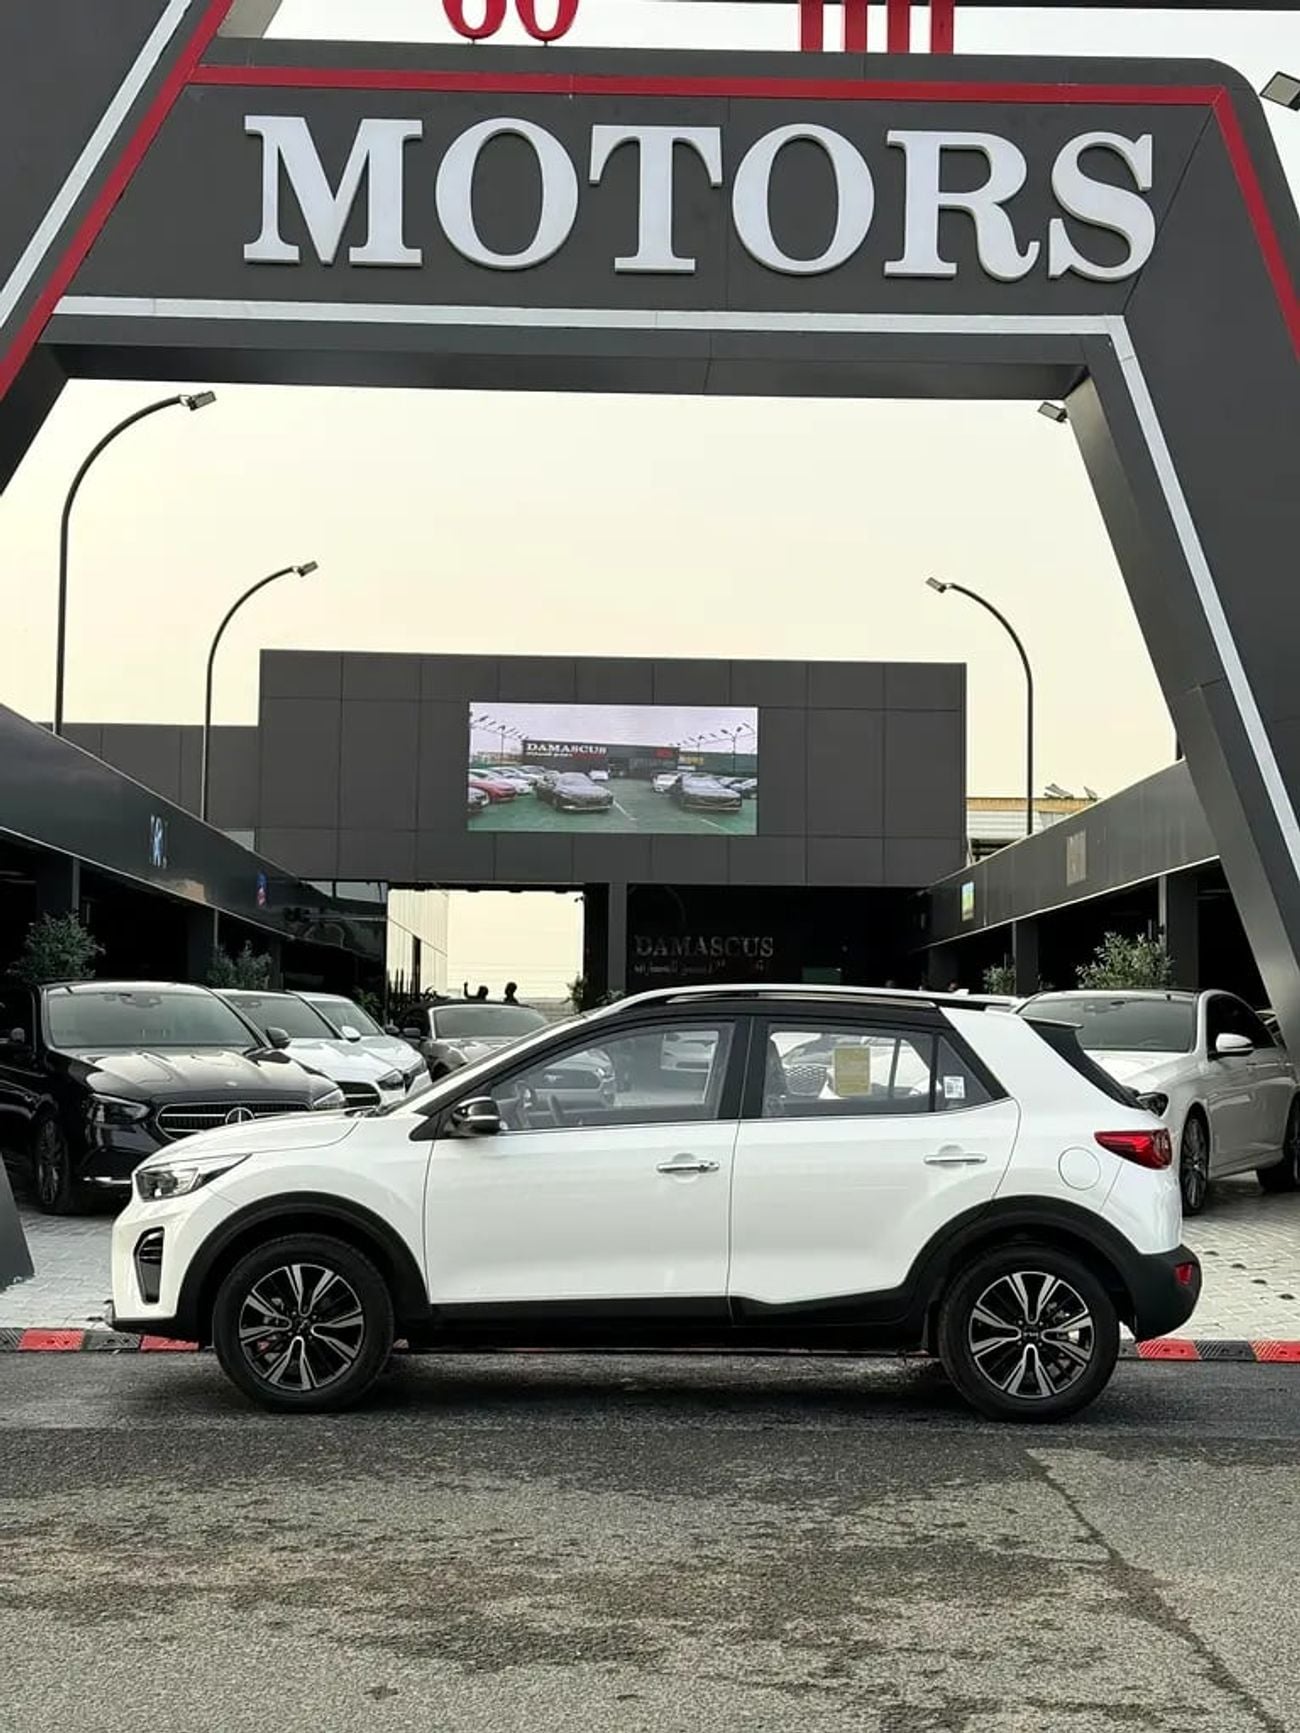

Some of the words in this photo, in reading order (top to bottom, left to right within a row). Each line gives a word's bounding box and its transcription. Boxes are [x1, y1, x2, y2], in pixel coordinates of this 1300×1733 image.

[243, 114, 1157, 283] MOTORS
[526, 742, 607, 755] DAMASCUS
[633, 935, 775, 958] DAMASCUS
